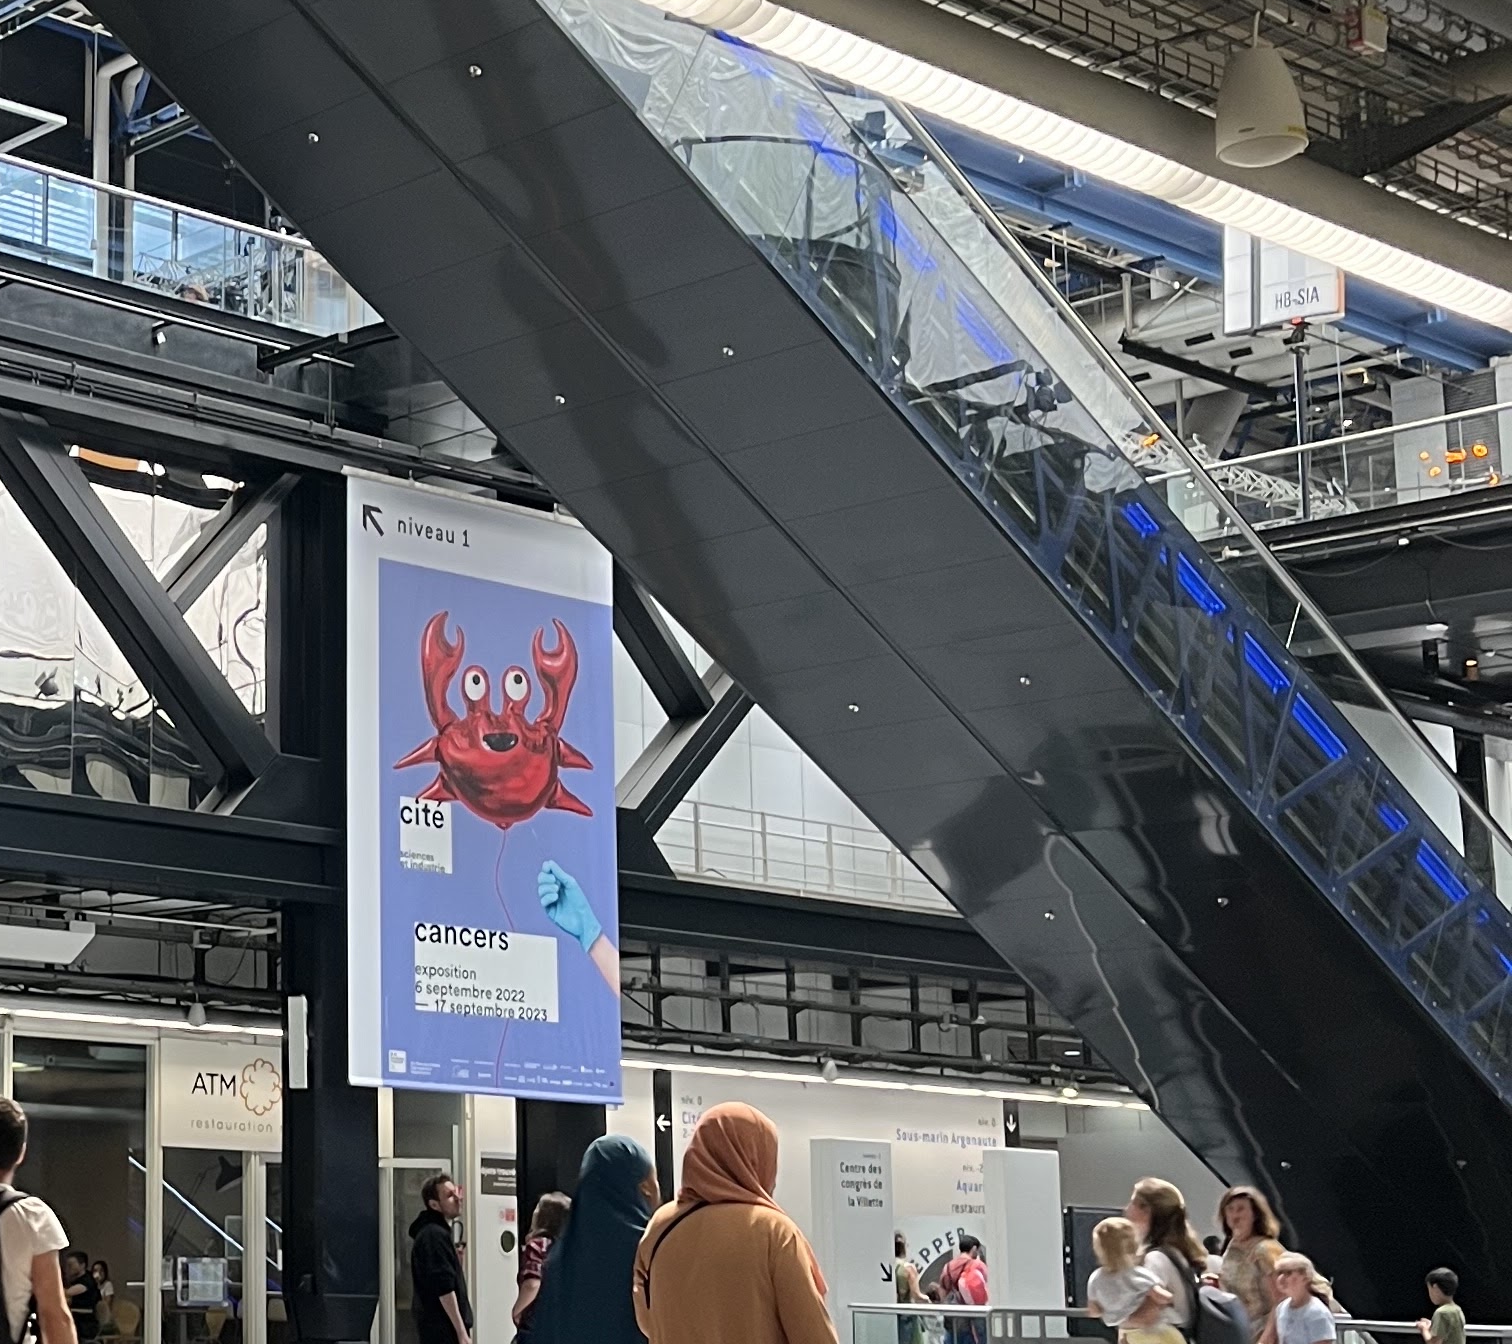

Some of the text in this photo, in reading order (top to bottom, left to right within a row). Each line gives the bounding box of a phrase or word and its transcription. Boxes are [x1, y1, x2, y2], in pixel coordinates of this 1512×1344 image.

[1275, 285, 1320, 311] HB-SIA
[397, 516, 471, 548] niveau 1
[400, 797, 445, 829] cité
[415, 922, 509, 951] cancers
[415, 964, 477, 980] exposition
[415, 981, 525, 1003] 6 septembre 2022
[435, 999, 446, 1013] 17
[450, 1003, 515, 1018] septembre
[518, 1006, 548, 1022] 2023
[191, 1119, 273, 1133] restauration
[896, 1128, 997, 1149] Sous-marin Argonaute
